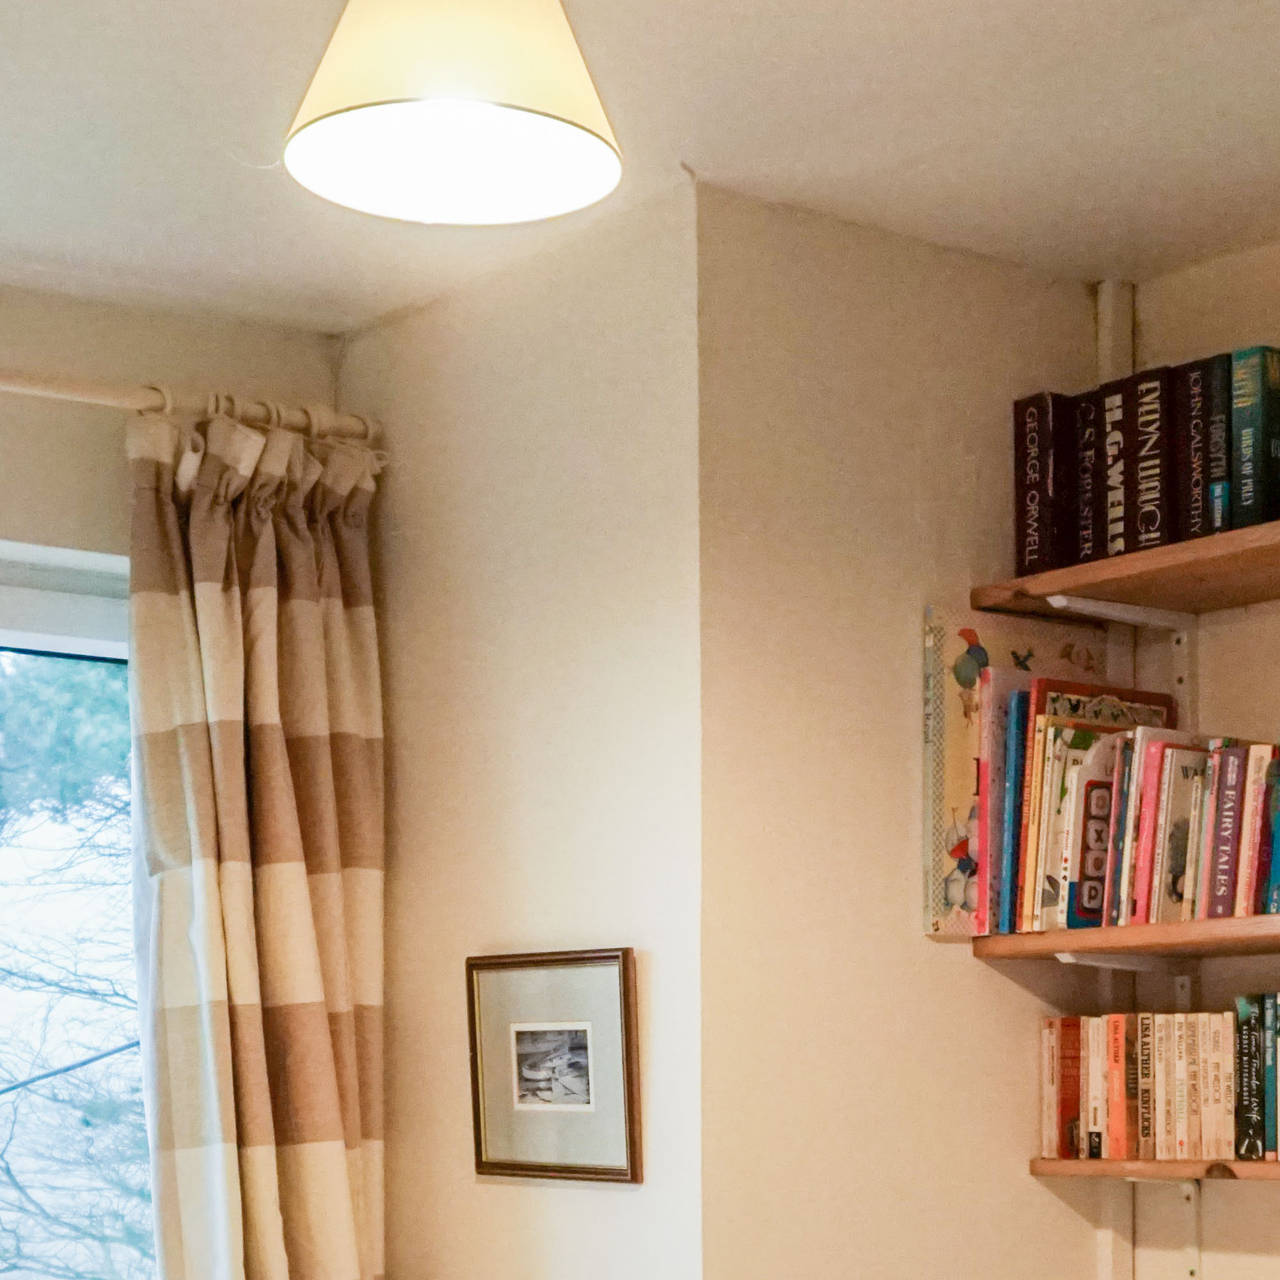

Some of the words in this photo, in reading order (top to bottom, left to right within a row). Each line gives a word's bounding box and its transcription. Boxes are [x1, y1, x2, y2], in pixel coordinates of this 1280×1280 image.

[1221, 789, 1238, 839] FAIRY
[1215, 842, 1232, 897] TALES
[1140, 1016, 1151, 1039] LISA
